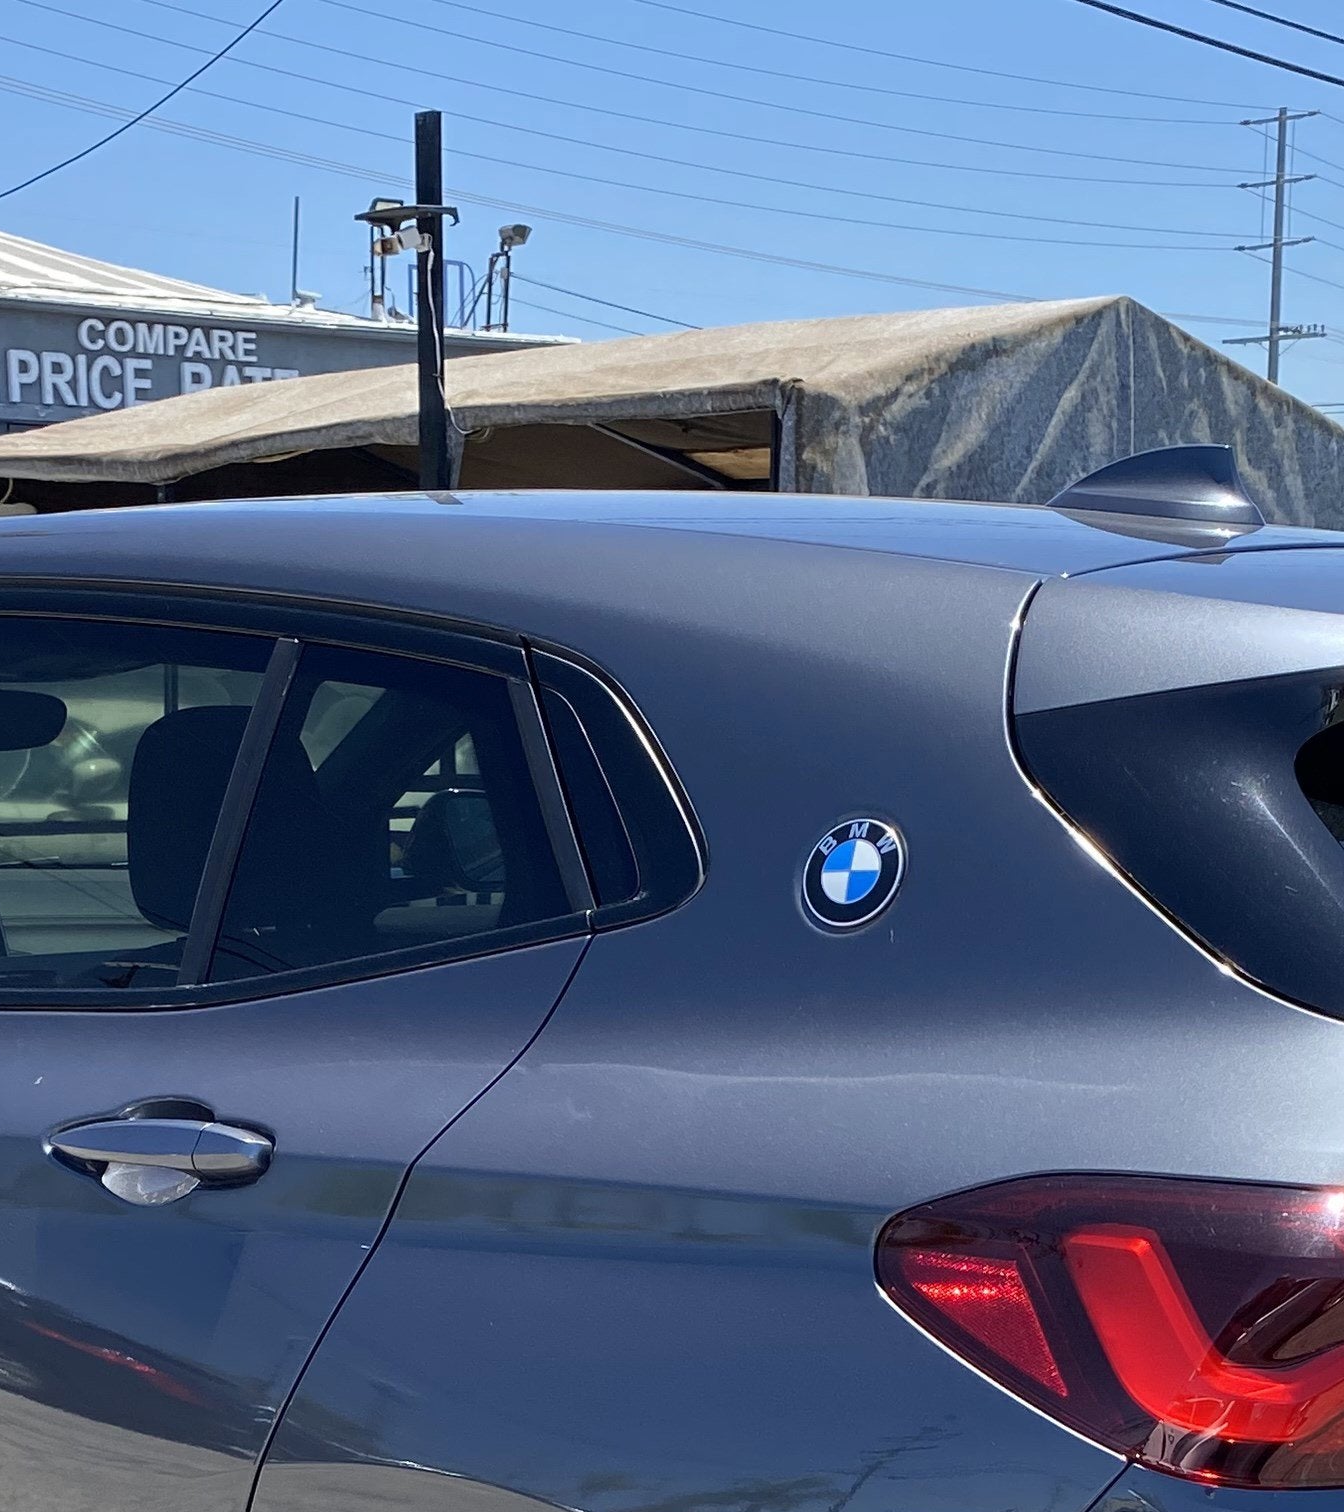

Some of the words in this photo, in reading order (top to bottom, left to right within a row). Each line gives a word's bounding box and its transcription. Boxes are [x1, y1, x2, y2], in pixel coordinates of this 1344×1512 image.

[78, 318, 257, 362] COMPARE
[6, 349, 153, 409] PRICE
[819, 822, 896, 856] BMW
